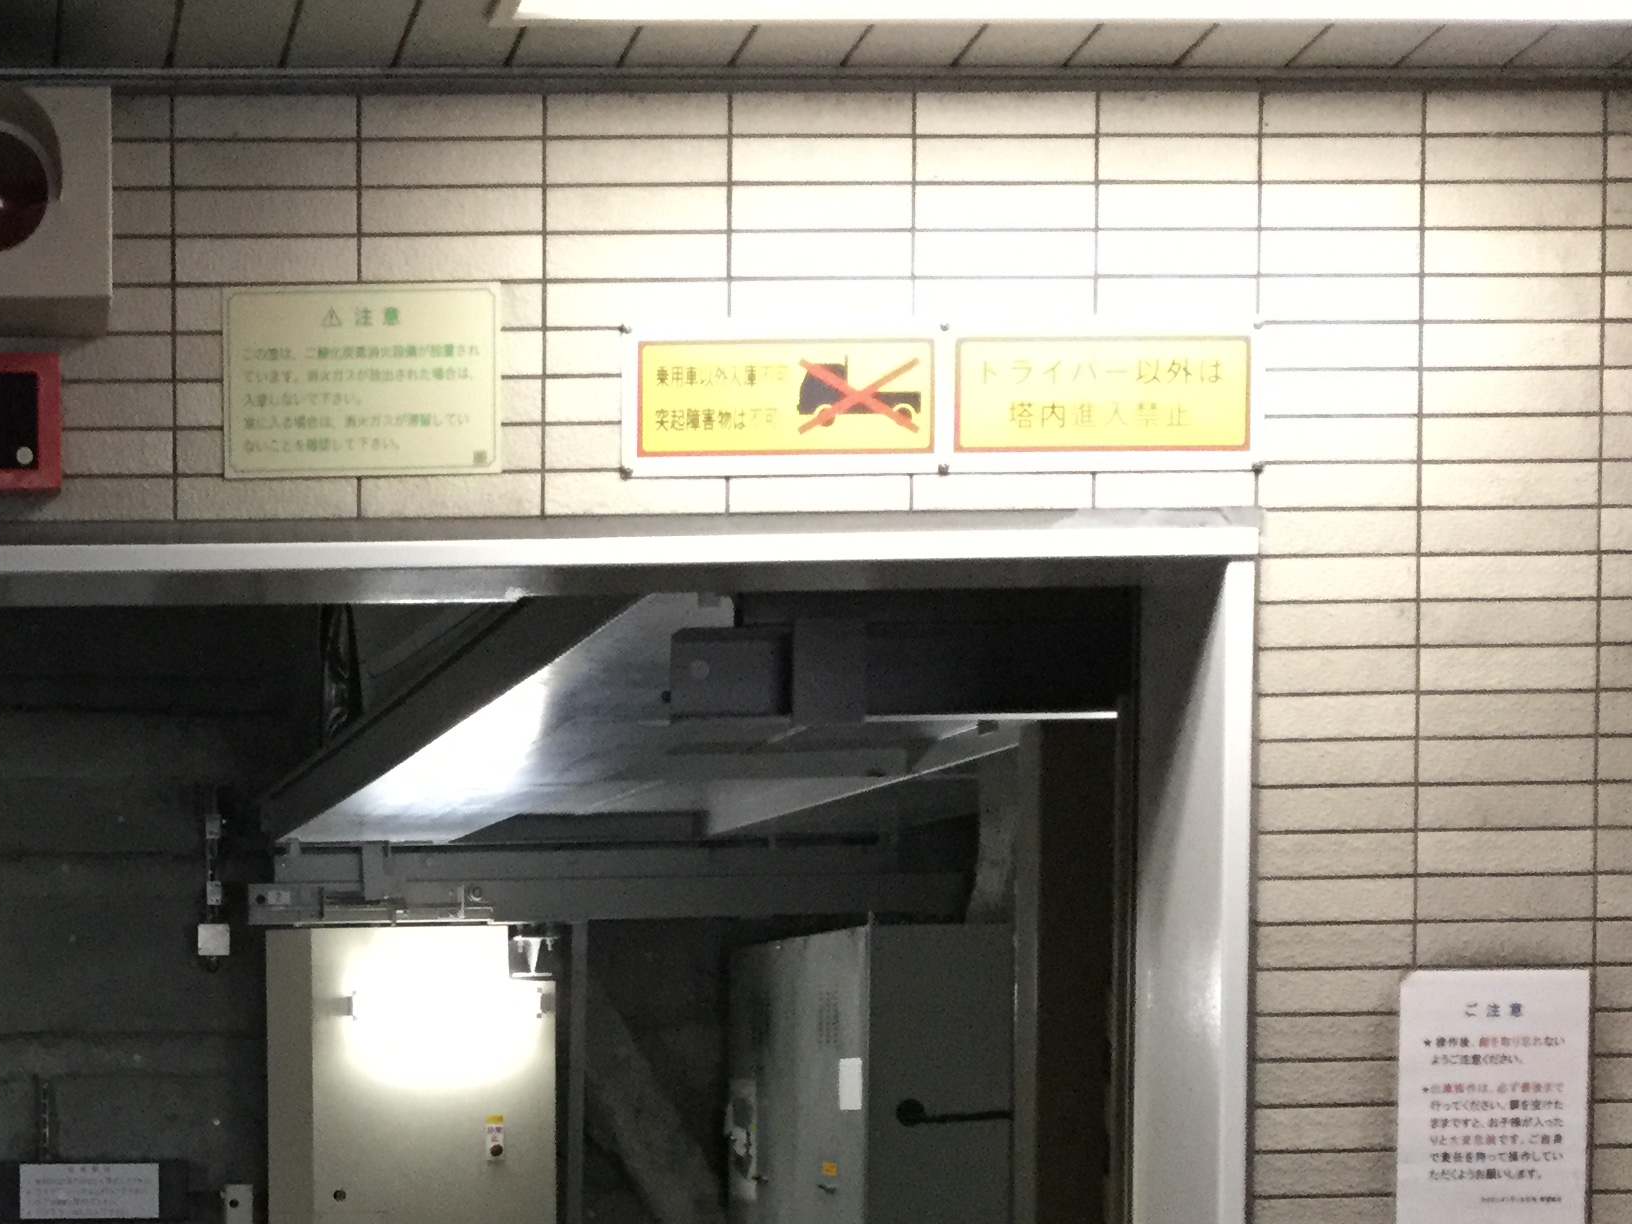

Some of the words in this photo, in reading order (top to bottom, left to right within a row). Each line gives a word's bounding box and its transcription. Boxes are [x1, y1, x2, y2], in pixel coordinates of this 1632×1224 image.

[655, 364, 789, 388] 乗用車以外入庫不可
[980, 358, 1223, 385] ドライバー以外は
[654, 407, 779, 432] 突起障害物は不可
[1008, 401, 1193, 429] 塔内進入禁止
[1464, 1002, 1524, 1018] ご注意
